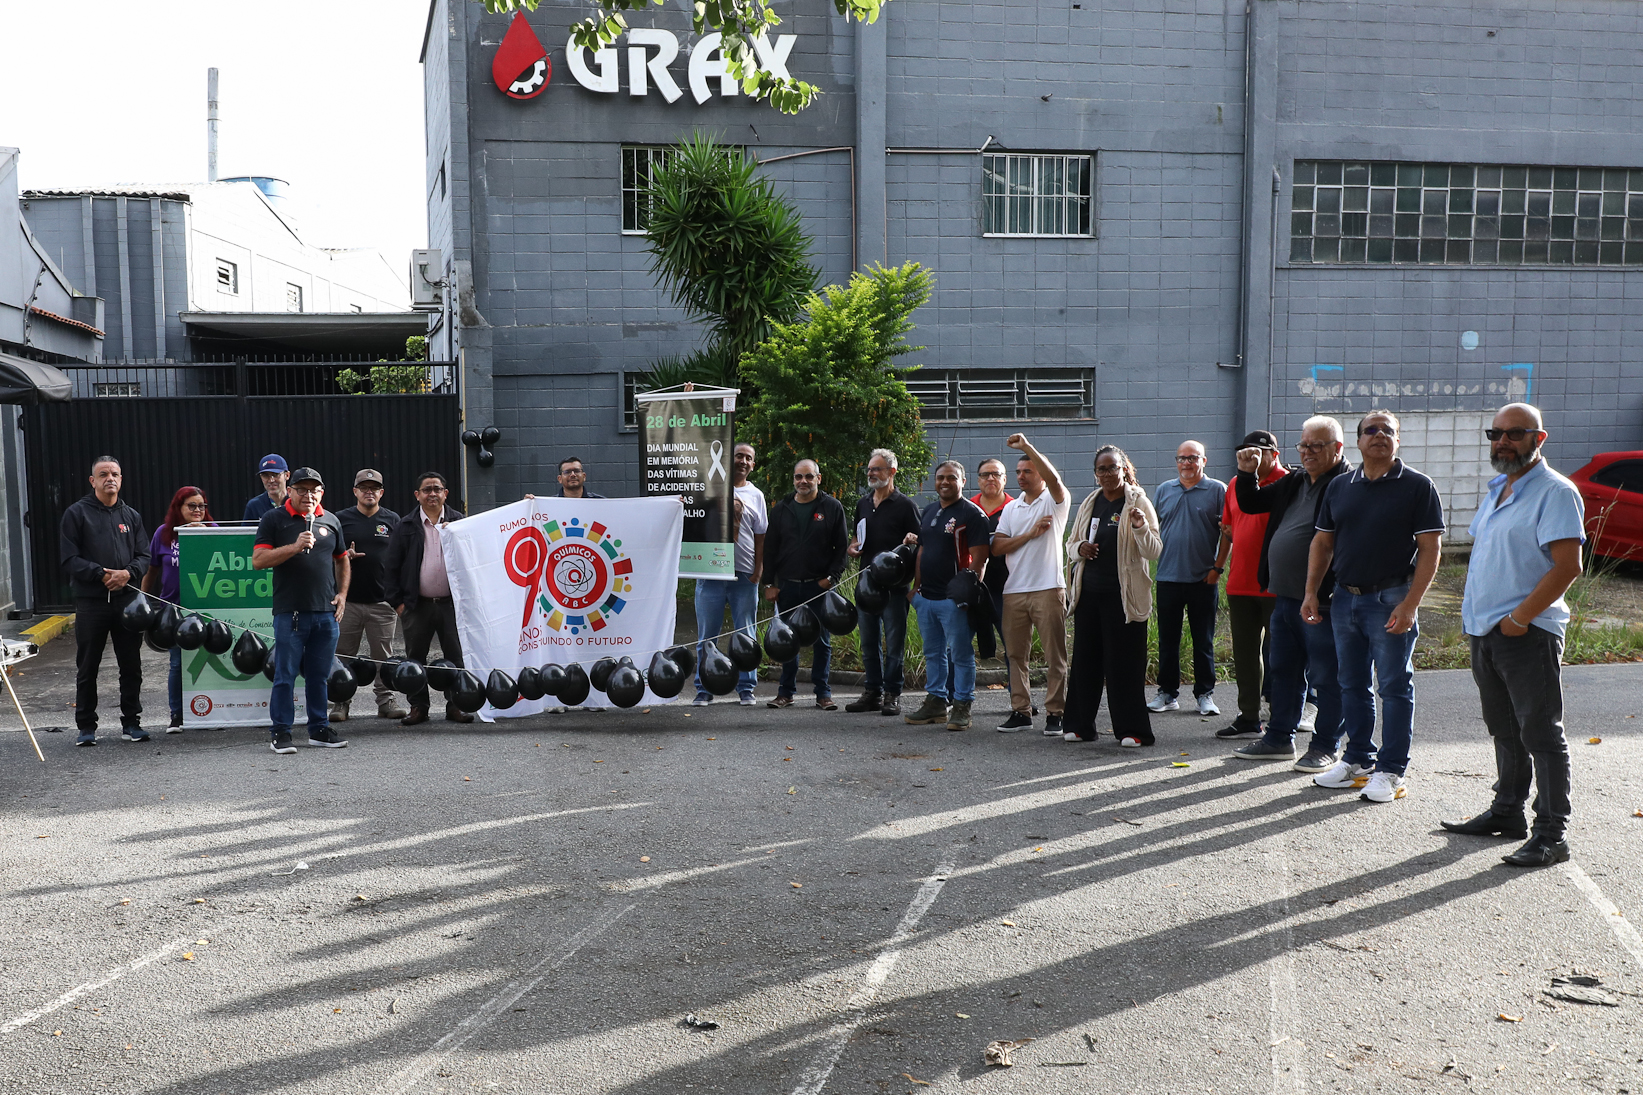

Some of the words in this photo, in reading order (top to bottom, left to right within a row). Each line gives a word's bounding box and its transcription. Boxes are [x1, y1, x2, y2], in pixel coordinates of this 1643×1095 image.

[565, 28, 798, 105] GRAX
[646, 415, 664, 429] 28
[668, 414, 686, 428] de
[690, 413, 727, 427] Abril
[646, 443, 661, 453] DIA
[662, 442, 699, 452] MUNDIAL
[647, 456, 660, 466] EM
[661, 454, 699, 465] MEMÓRIA
[647, 469, 664, 479] DAS
[665, 467, 698, 478] VÍTIMAS
[647, 482, 659, 492] DE
[660, 482, 706, 492] ACIDENTES
[683, 509, 706, 518] ALHO
[499, 517, 527, 533] RUMO
[207, 551, 273, 571] Abr
[553, 545, 597, 563] QUÍMICOS
[187, 572, 273, 599] Verd
[518, 625, 543, 646] ANO
[575, 637, 584, 646] O
[587, 636, 633, 646] FUTURO
